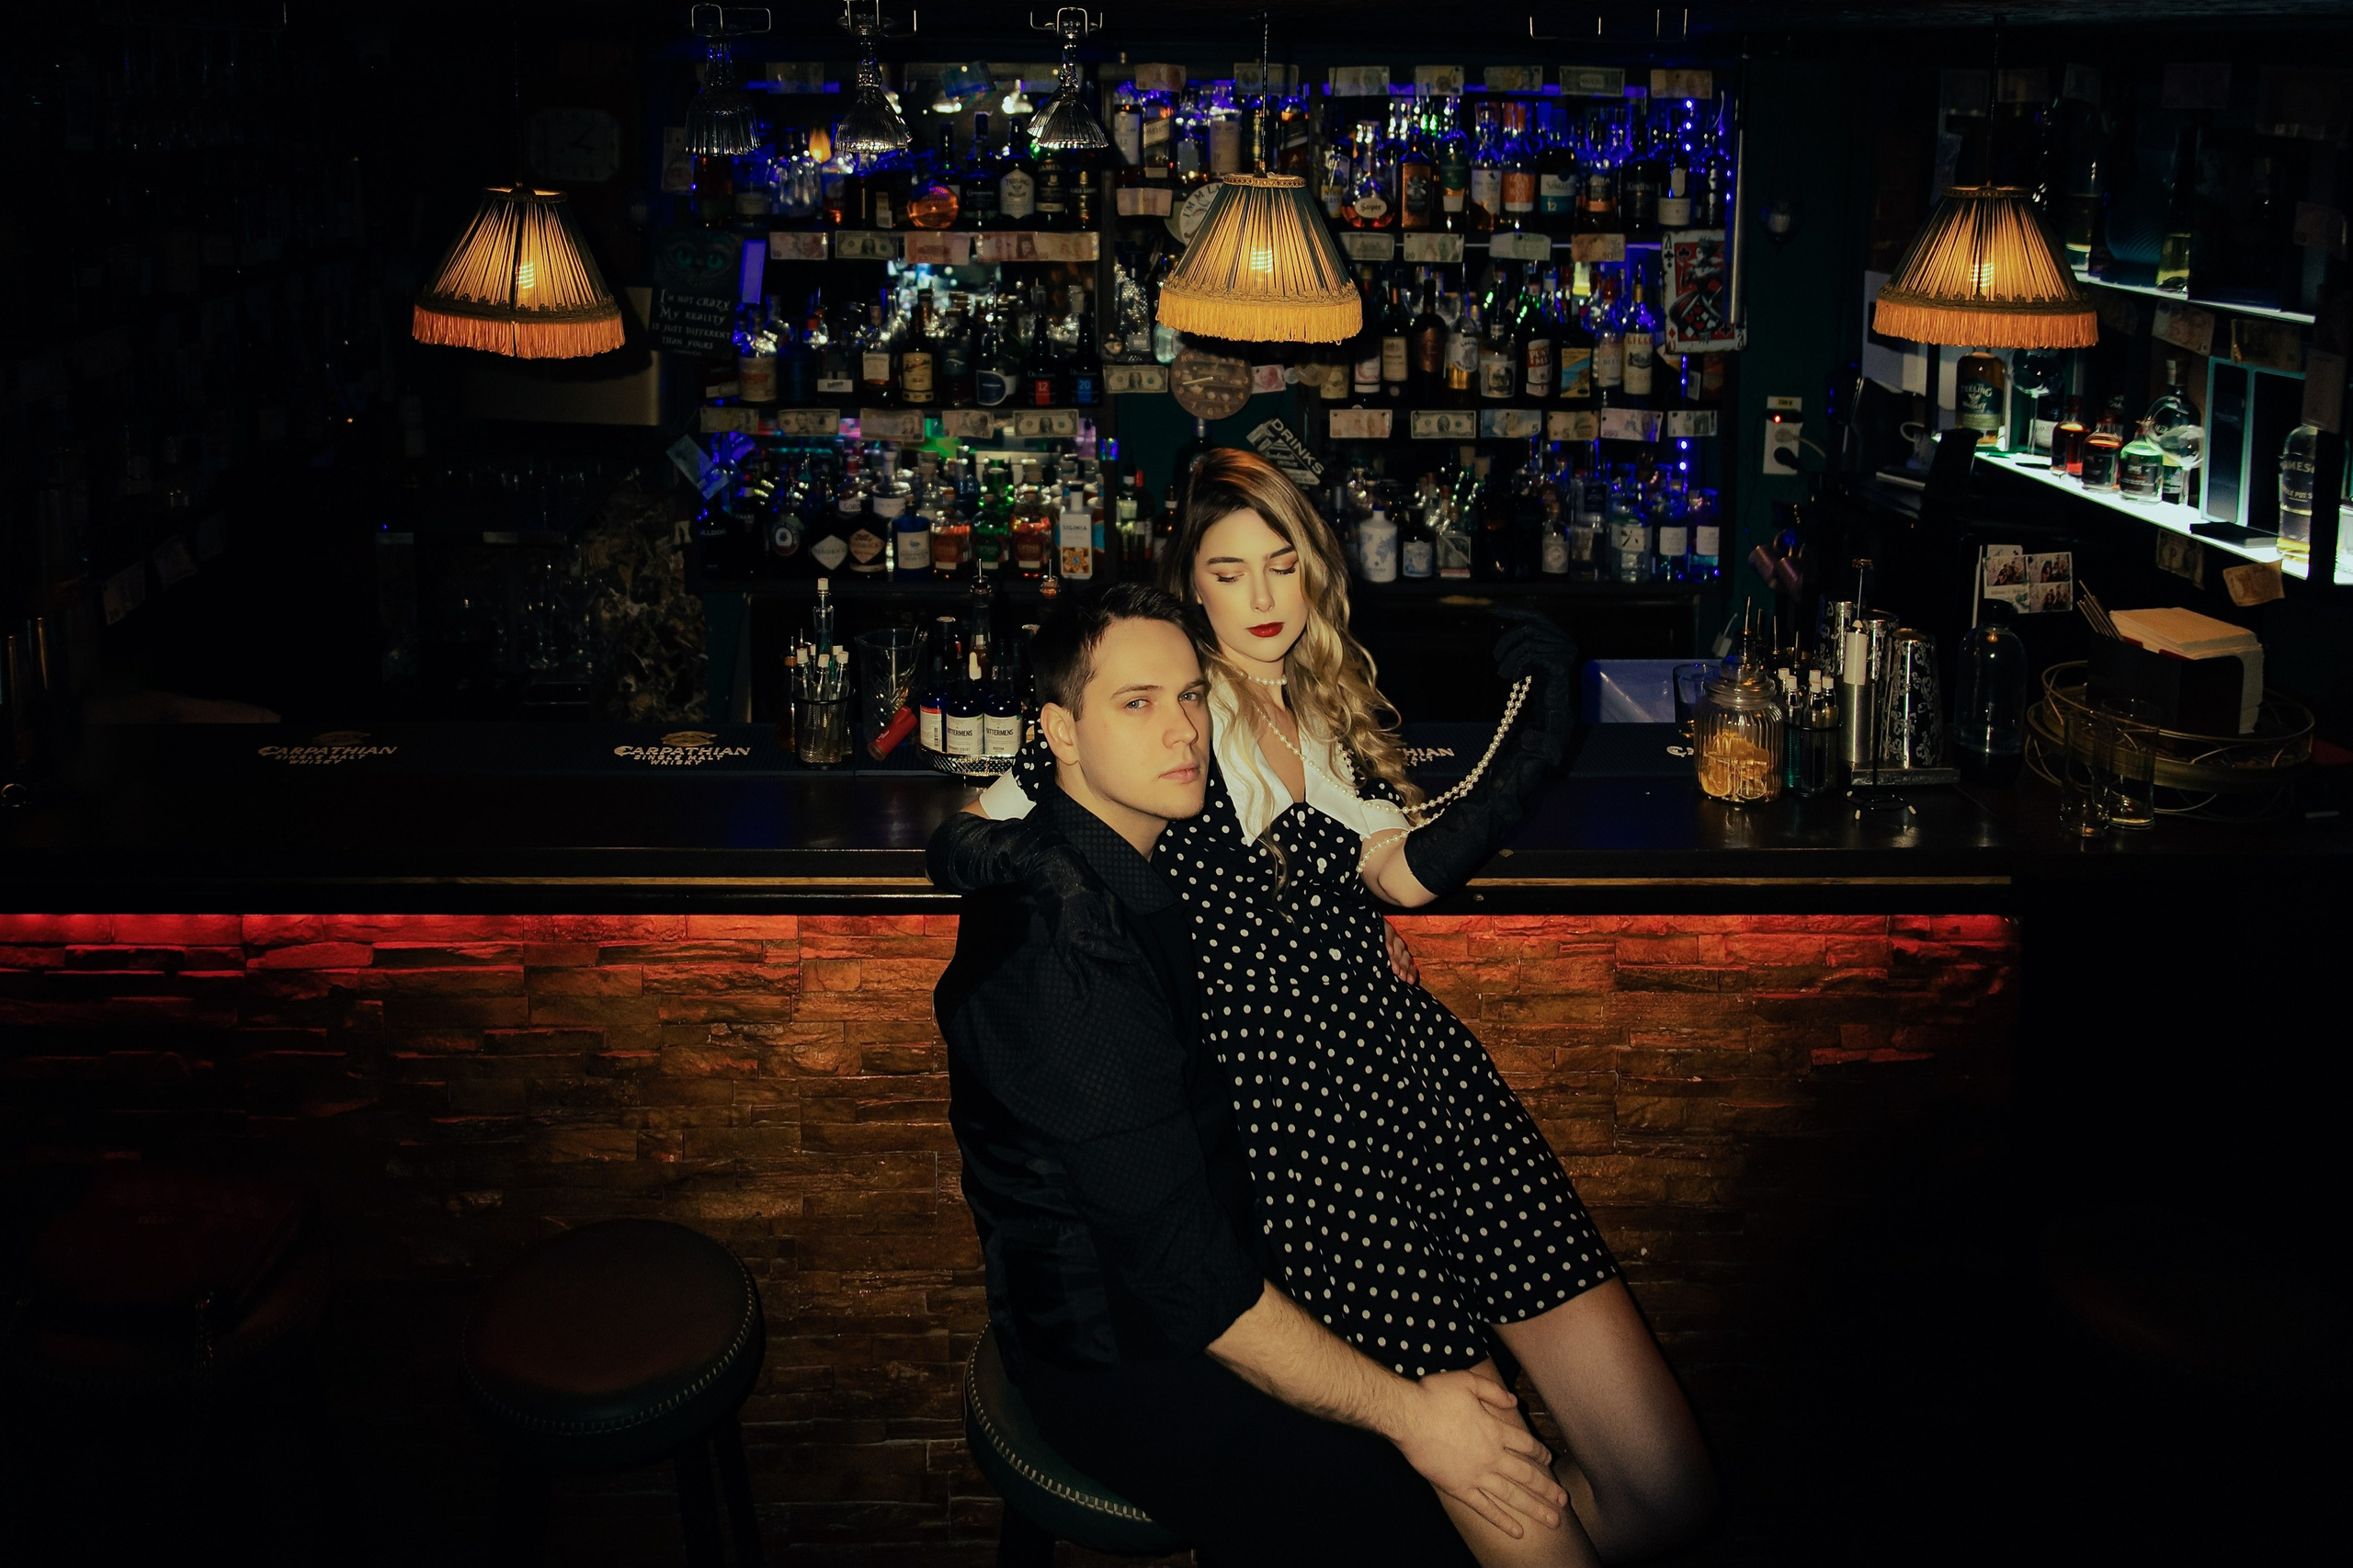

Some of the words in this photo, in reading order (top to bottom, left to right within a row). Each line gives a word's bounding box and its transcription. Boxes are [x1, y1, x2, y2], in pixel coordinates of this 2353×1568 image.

[1360, 202, 1382, 212] Super
[1547, 199, 1557, 212] 12
[663, 324, 683, 333] JUST
[686, 326, 731, 339] DIFFERENT
[688, 340, 714, 350] YOURS
[1038, 381, 1048, 392] 12
[1078, 380, 1091, 390] 20
[1961, 384, 1993, 397] TEELING
[1271, 418, 1324, 475] DRINKS
[986, 727, 1014, 736] BITTERMENS
[257, 745, 398, 756] CARPATHIAN
[613, 745, 752, 756] CARPATHIAN
